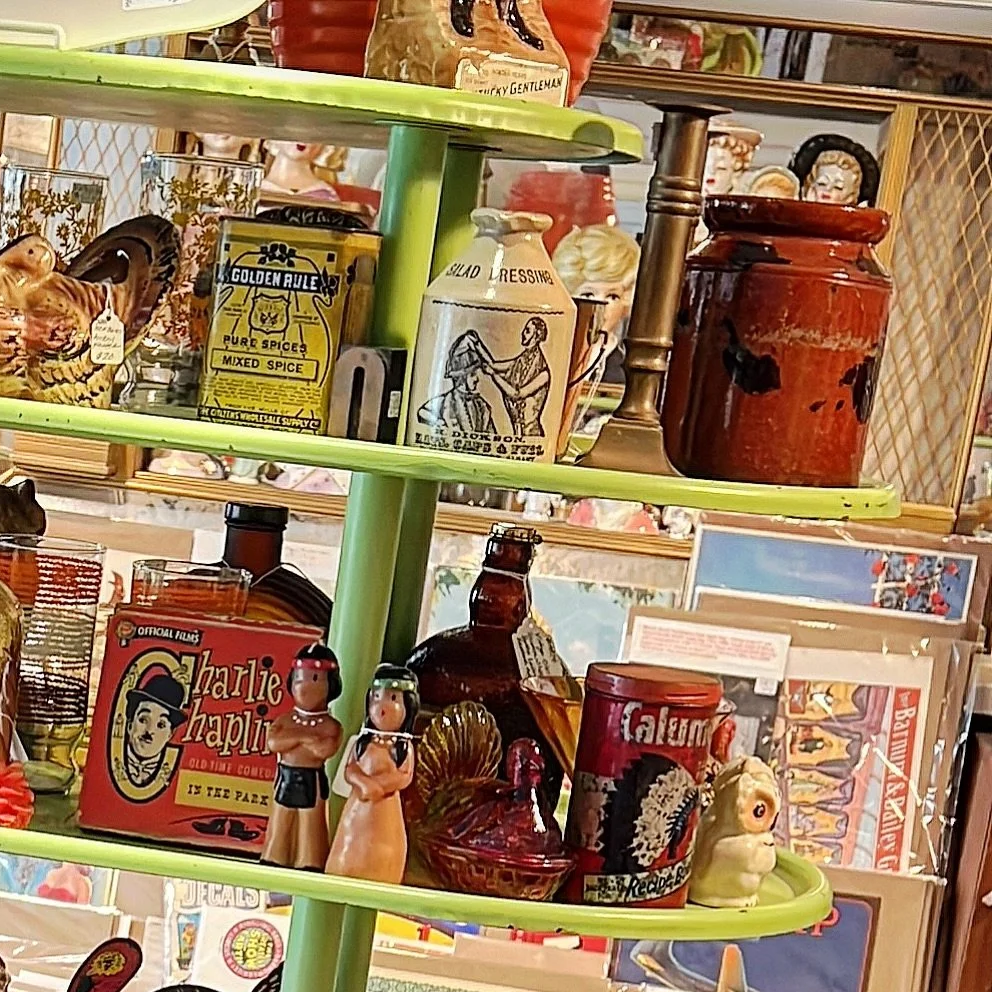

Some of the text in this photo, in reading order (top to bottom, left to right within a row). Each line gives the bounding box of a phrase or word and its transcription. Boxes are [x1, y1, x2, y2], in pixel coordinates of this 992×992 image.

[509, 77, 563, 95] GENTLEMAN
[231, 267, 319, 291] GOLDEN RULE
[223, 334, 308, 354] PURE SPICES
[222, 354, 304, 374] MIXED SPICE
[239, 411, 280, 426] WHOLESALE
[281, 416, 309, 428] SUPPLY
[137, 626, 174, 640] OFFICIAL
[620, 701, 710, 748] Calum
[887, 706, 917, 779] Barnum
[188, 757, 274, 779] OLD TIME COMED
[187, 784, 269, 806] IN THE PARK
[885, 781, 905, 798] &
[877, 798, 903, 854] Bailey
[181, 880, 260, 910] DECALS
